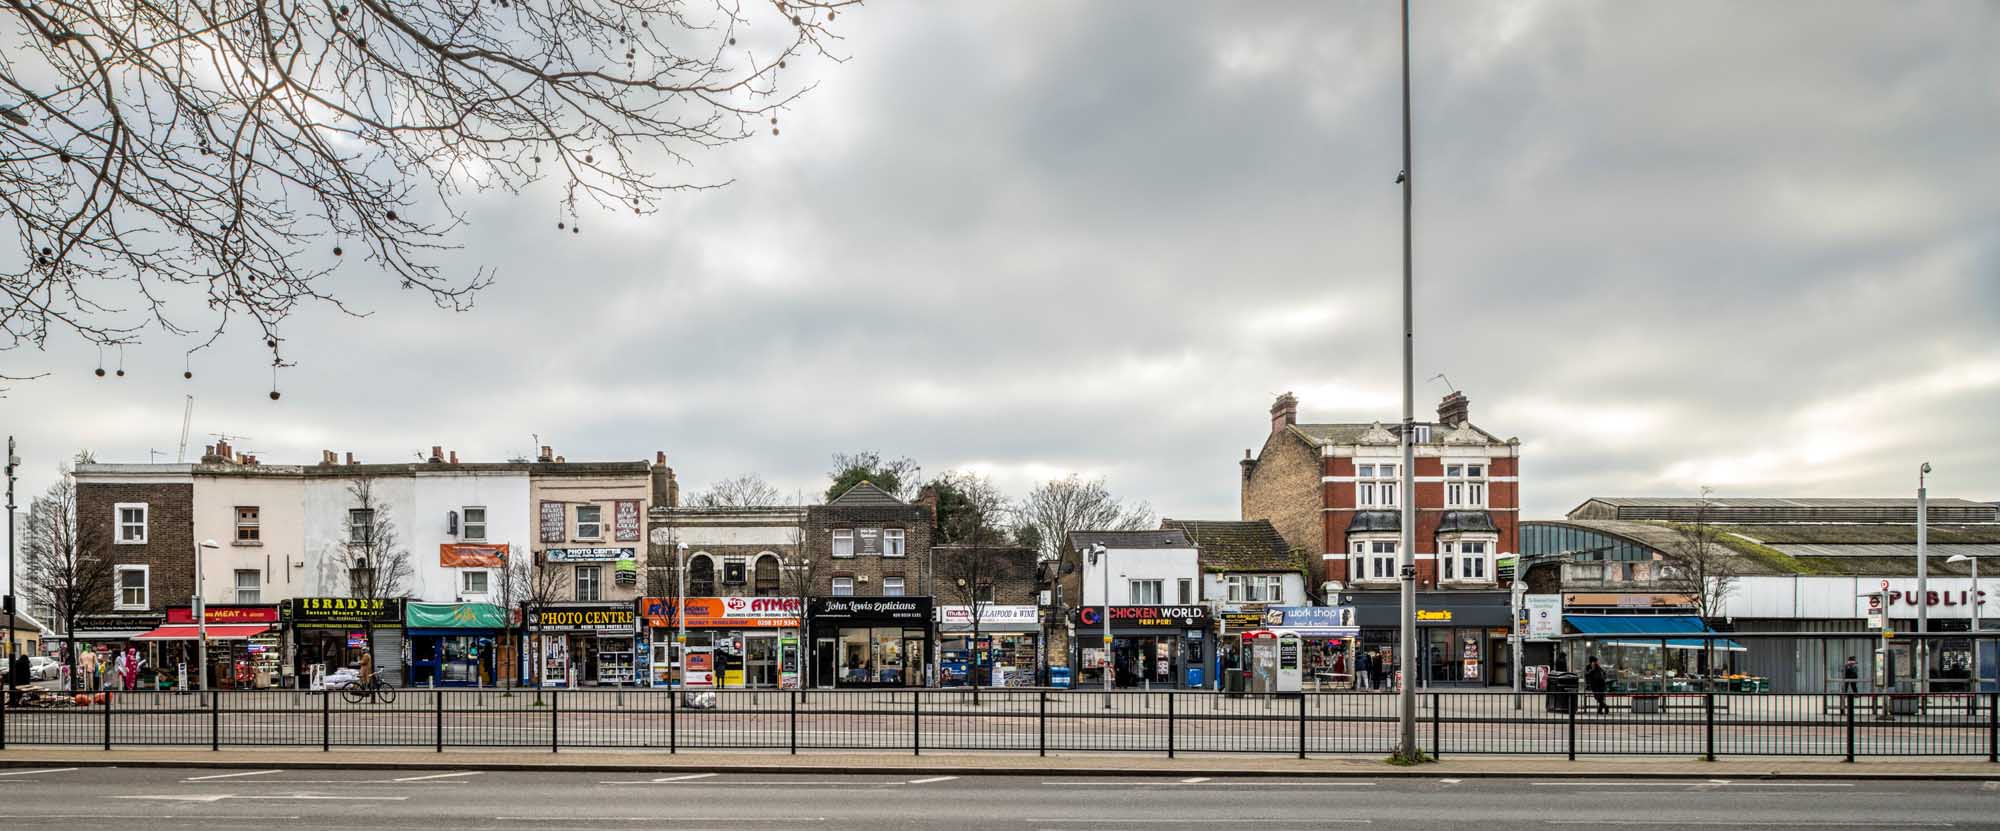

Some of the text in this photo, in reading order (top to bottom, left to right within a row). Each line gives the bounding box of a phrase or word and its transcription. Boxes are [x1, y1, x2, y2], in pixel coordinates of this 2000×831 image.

[825, 601, 916, 612] John Lewis Opticians
[214, 610, 241, 618] MEAT
[541, 611, 633, 624] PHOTO CENTRE
[1109, 608, 1157, 618] CHICKEN
[1288, 608, 1337, 618] work shop
